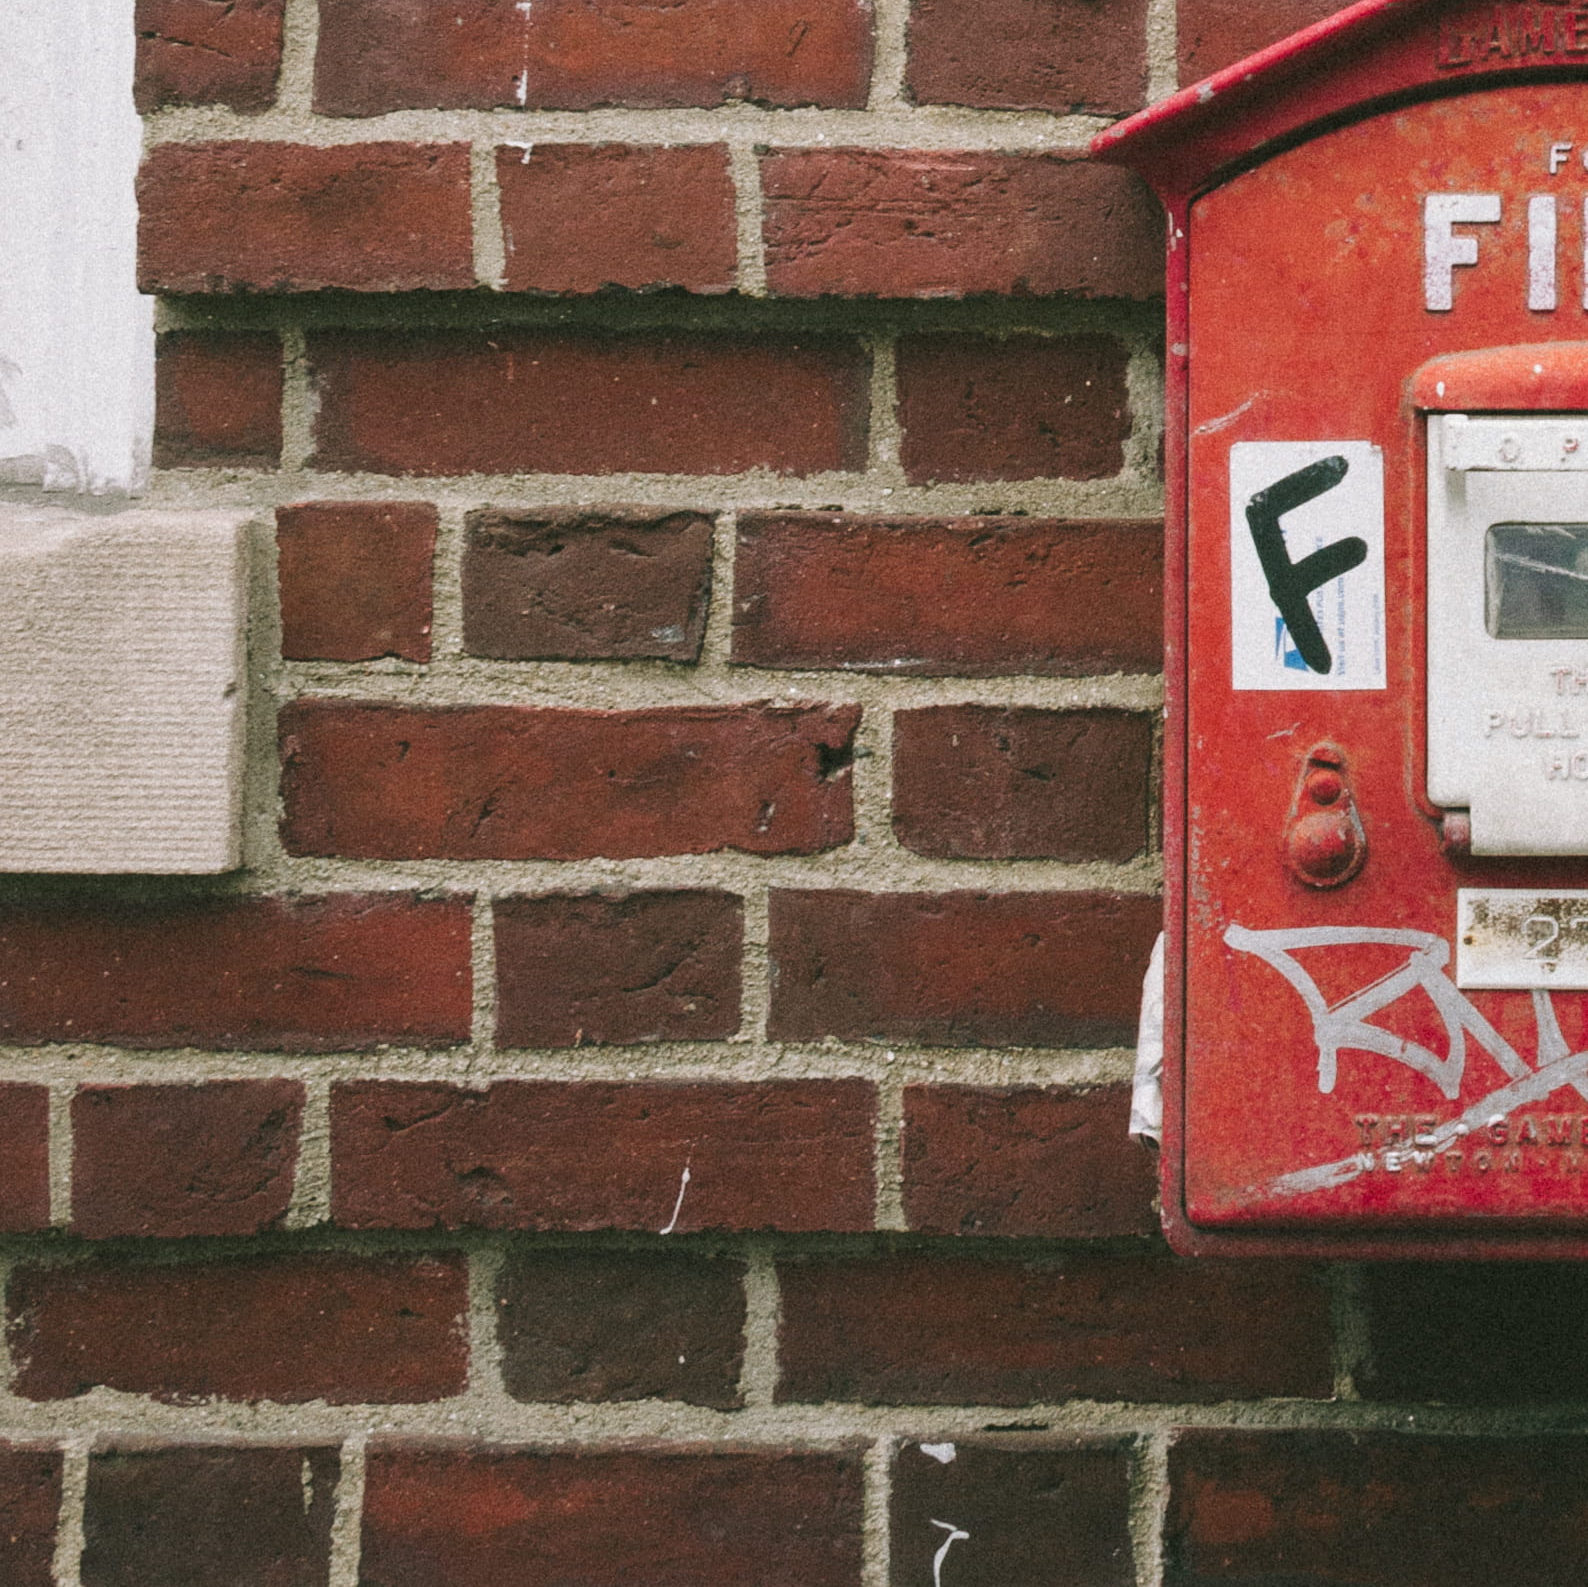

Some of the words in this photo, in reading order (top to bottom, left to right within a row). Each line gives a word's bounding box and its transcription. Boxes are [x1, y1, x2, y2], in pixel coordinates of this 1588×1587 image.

[1485, 709, 1581, 739] PULL
[1355, 1114, 1436, 1148] THE
[1356, 1150, 1520, 1175] NEWTON
